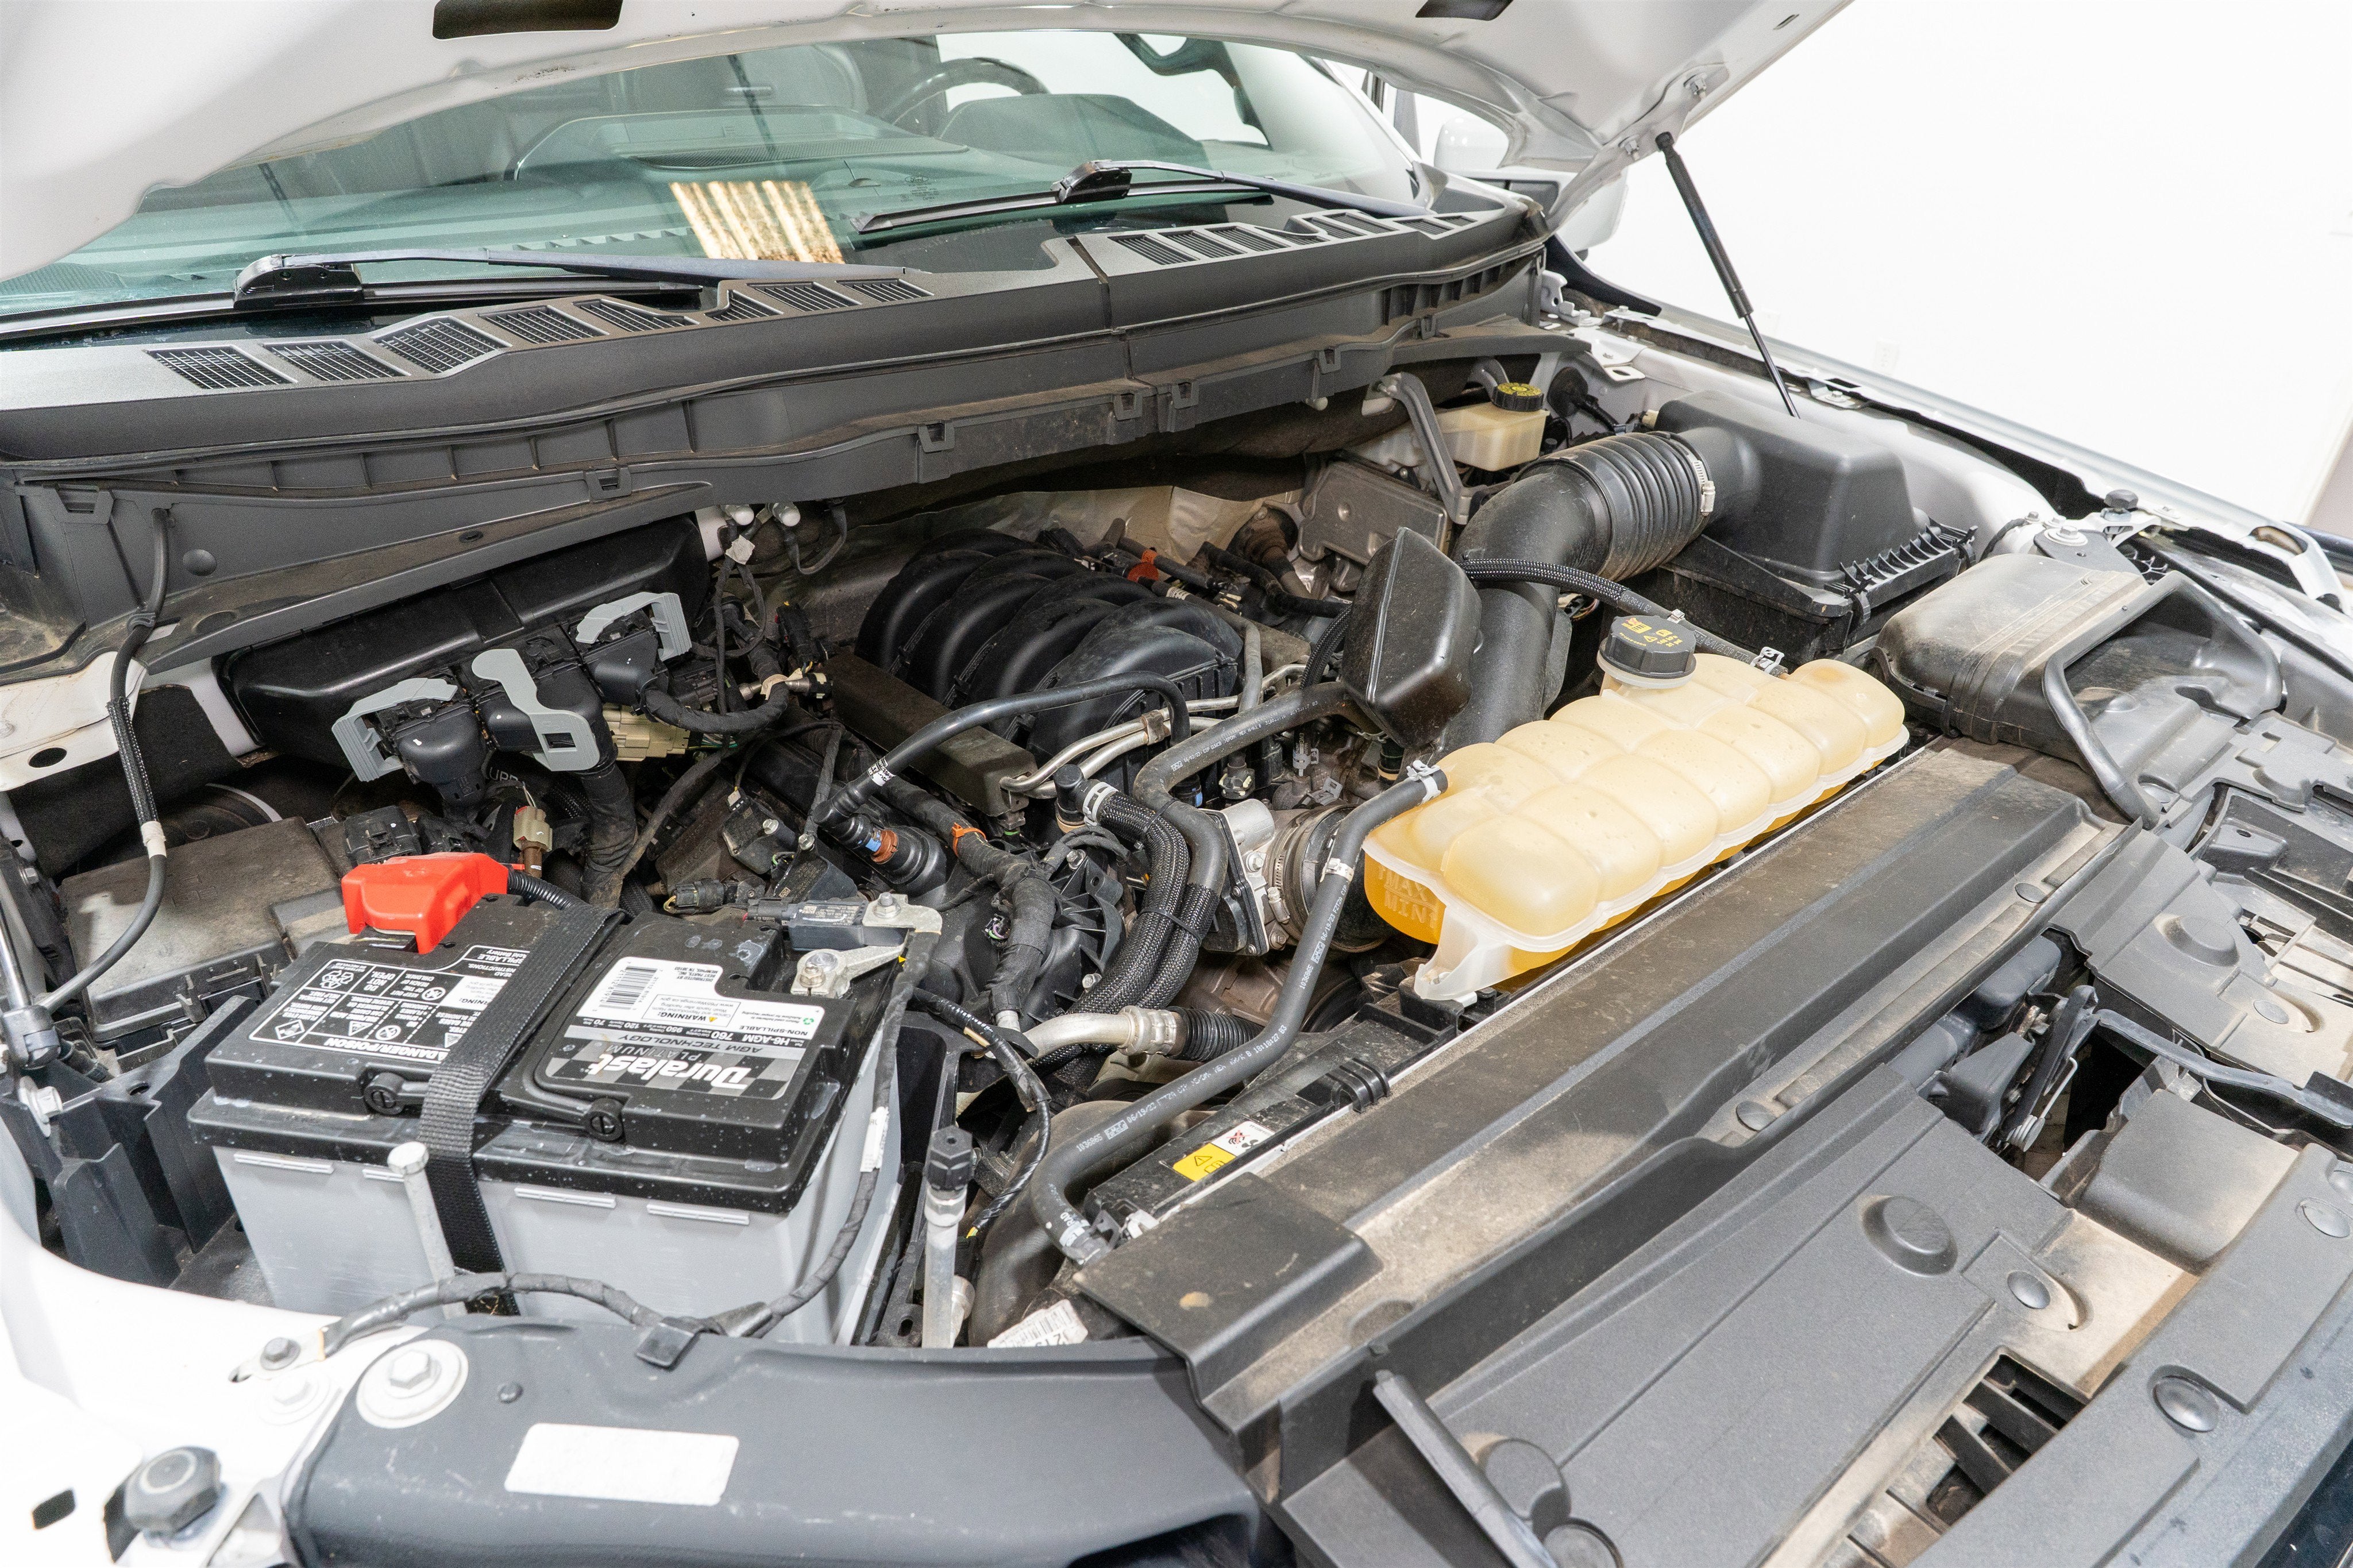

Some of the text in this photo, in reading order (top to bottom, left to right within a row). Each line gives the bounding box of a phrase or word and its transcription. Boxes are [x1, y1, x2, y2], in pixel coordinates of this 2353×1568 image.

[1384, 890, 1426, 924] MIN
[1299, 964, 1314, 989] 1036865
[1321, 913, 1335, 941] 06/19/23
[1340, 885, 1349, 895] CIP
[365, 978, 388, 986] NOT
[367, 971, 398, 980] OPEN.
[657, 1011, 706, 1020] WARNING:
[665, 1025, 684, 1033] 950
[709, 1030, 734, 1040] 760
[738, 1025, 807, 1035] NON-SPILLABLE
[618, 1034, 720, 1049] TECHNOLOGY
[741, 1034, 790, 1045] H6-AGM
[322, 1037, 441, 1059] DANGER/POISON
[604, 1044, 702, 1061] PLATINUM
[587, 1053, 751, 1090] Duralast
[1075, 1133, 1103, 1152] 1036865
[1253, 1033, 1280, 1053] 18:18:27
[1278, 1024, 1287, 1034] B3
[1058, 1211, 1075, 1227] RAD
